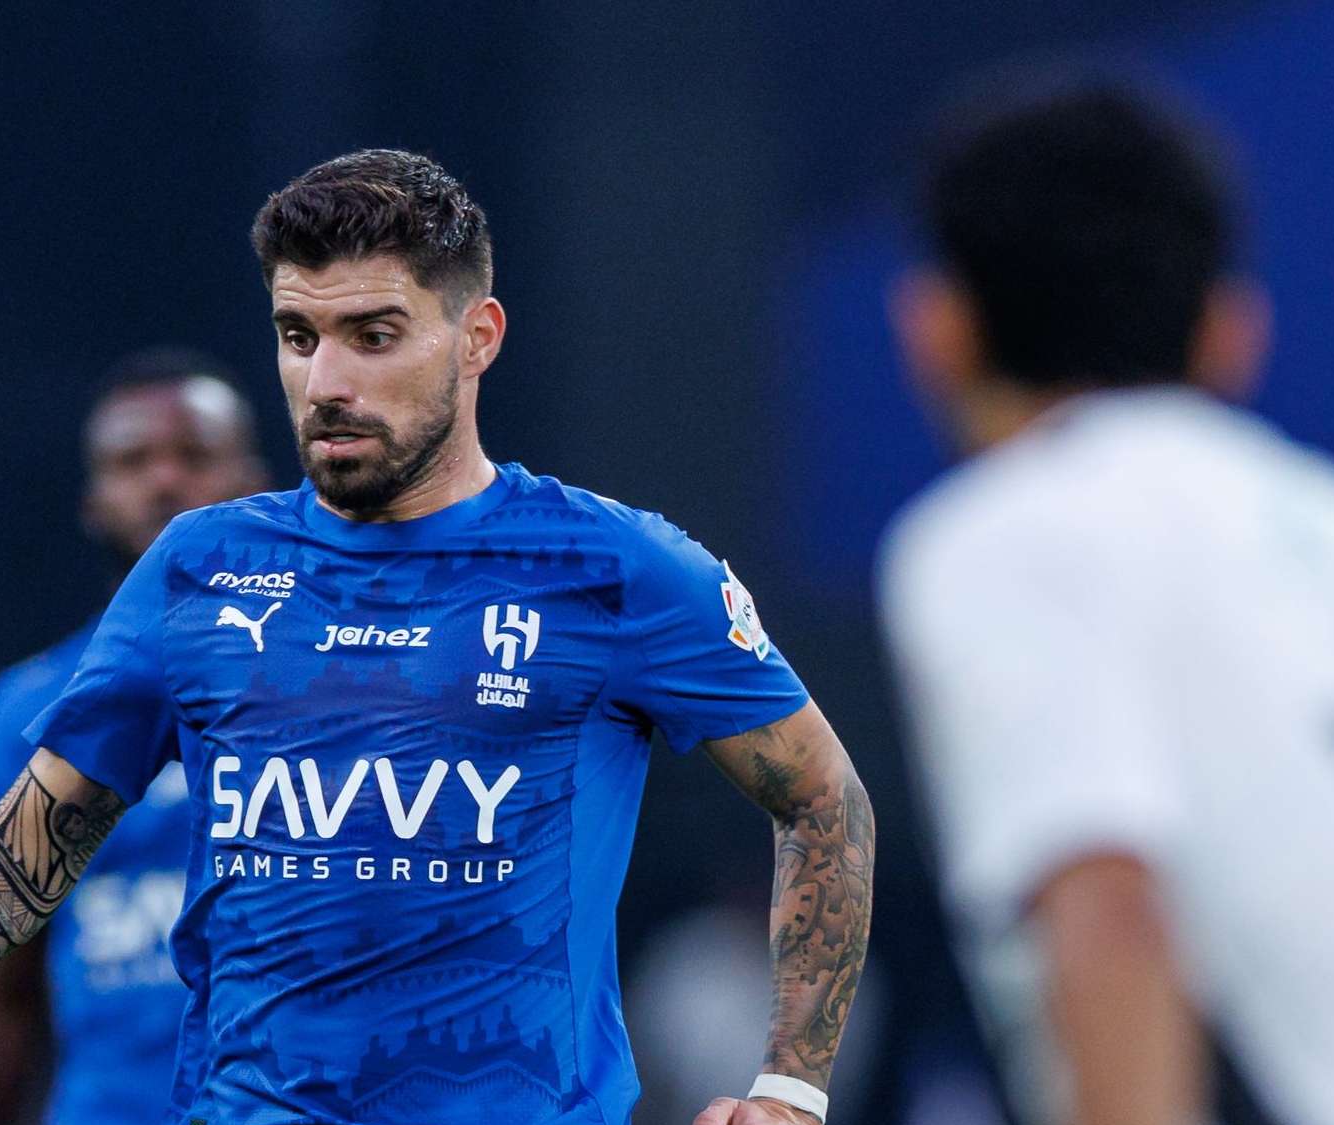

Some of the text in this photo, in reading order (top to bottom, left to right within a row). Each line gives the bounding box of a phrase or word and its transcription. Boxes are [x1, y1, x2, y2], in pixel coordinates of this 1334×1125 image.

[210, 756, 521, 844] SAVVY
[215, 855, 514, 883] GAMES GROUP
